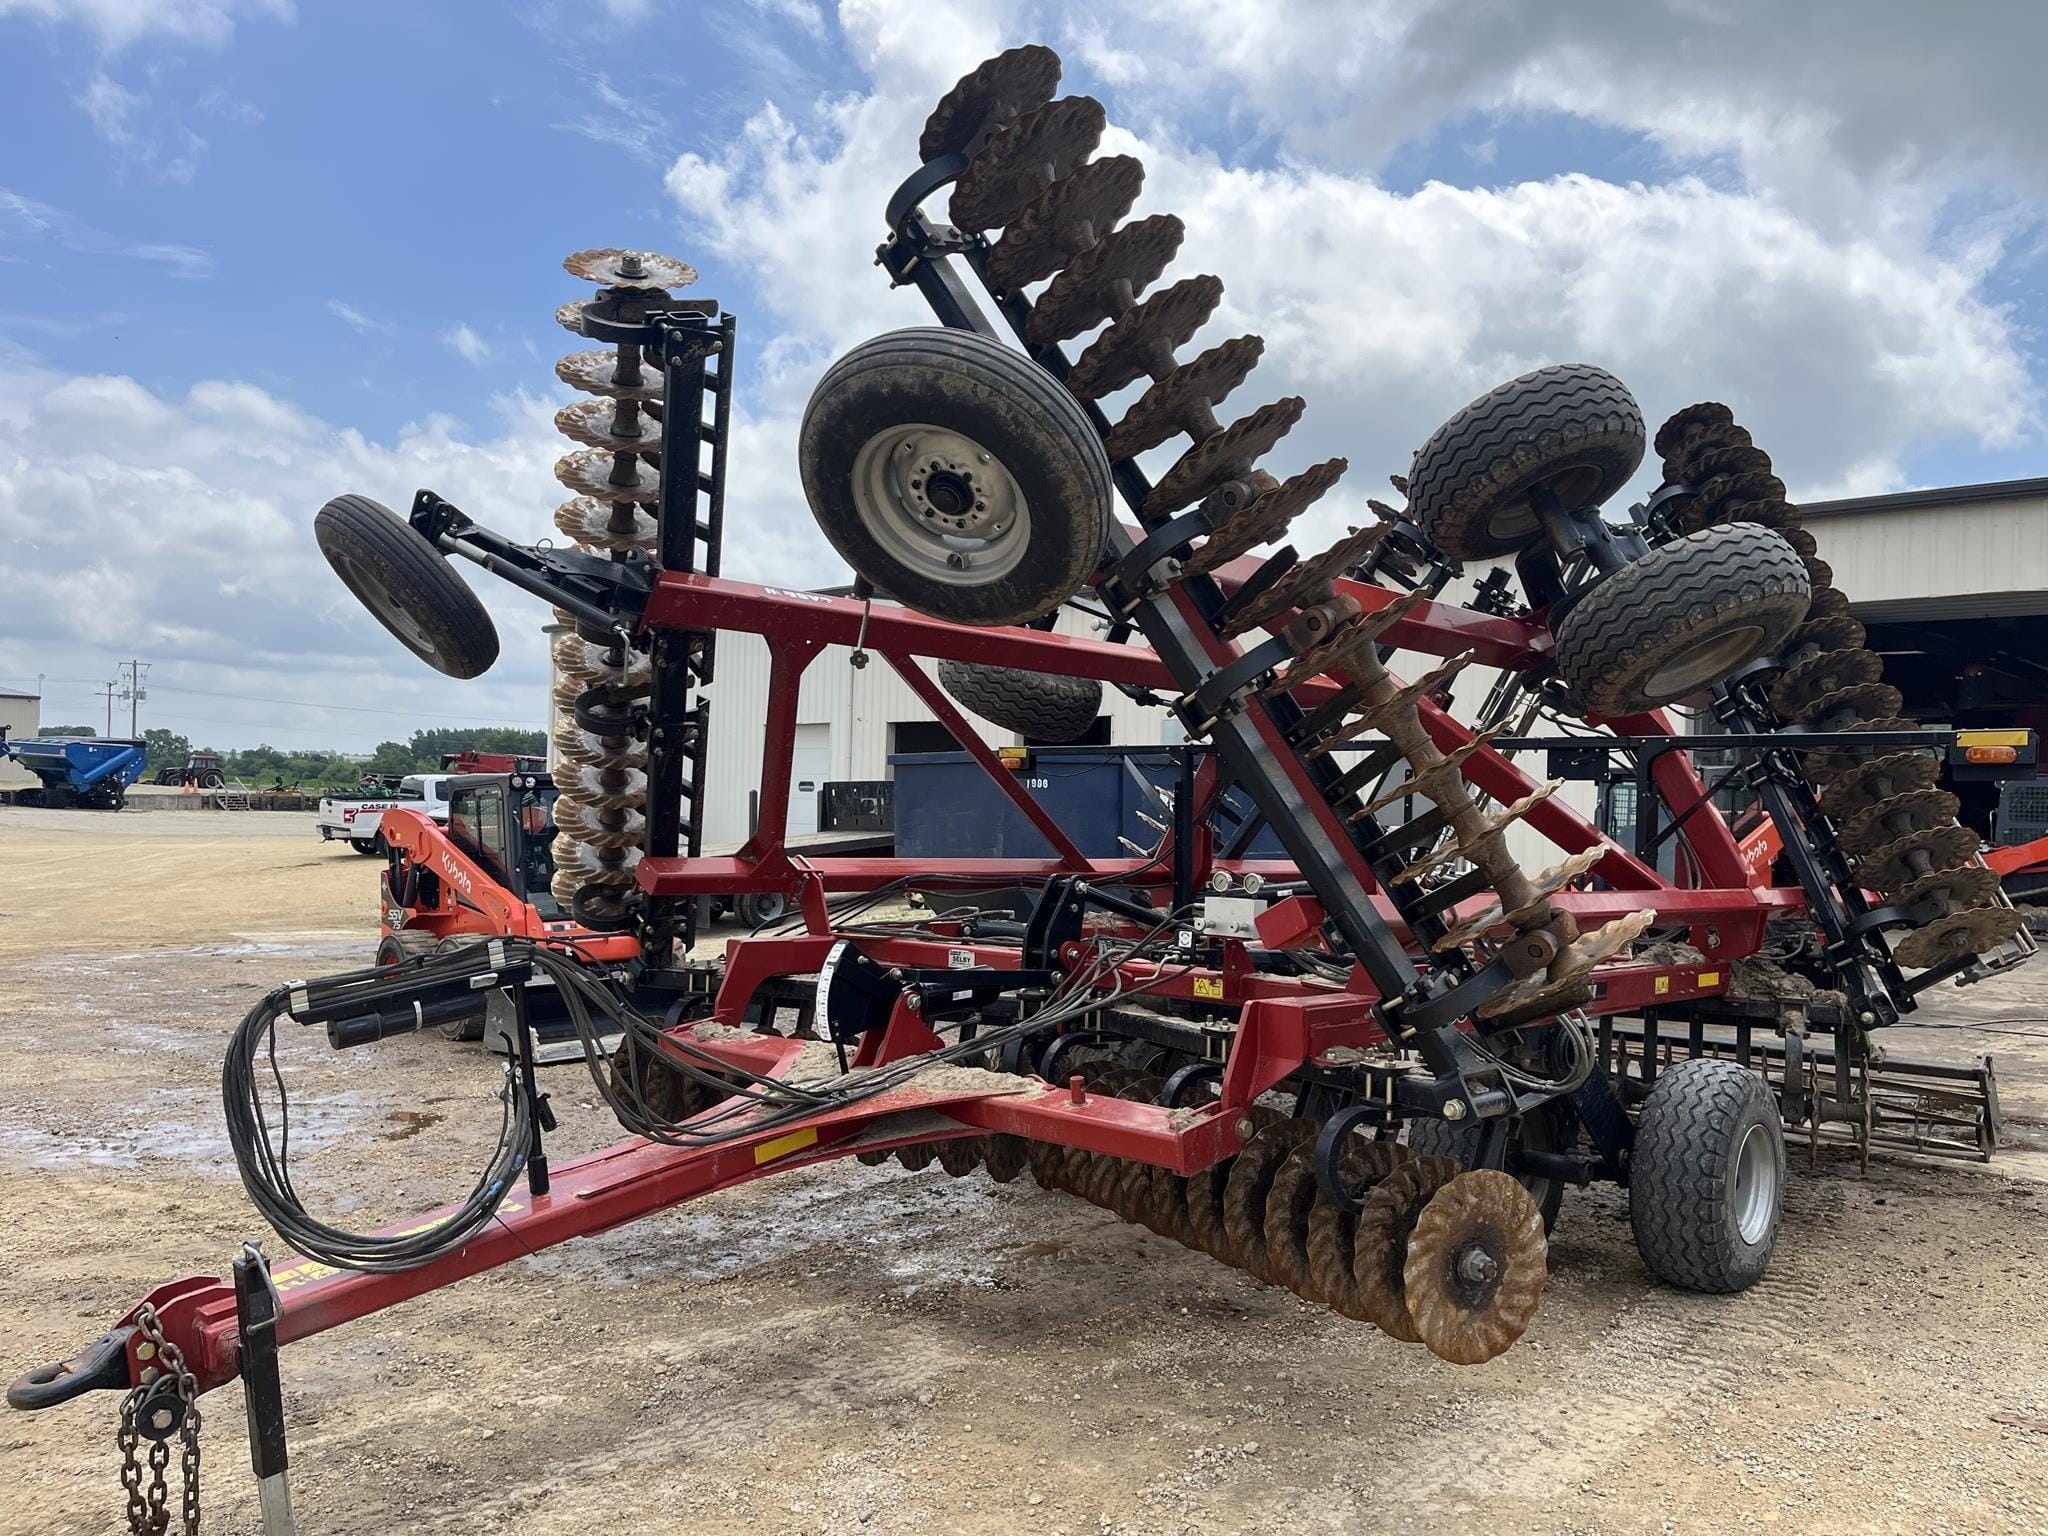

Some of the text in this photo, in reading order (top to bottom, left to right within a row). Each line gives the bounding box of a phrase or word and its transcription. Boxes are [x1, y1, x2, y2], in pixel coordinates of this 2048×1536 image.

[441, 850, 472, 894] Kubota
[387, 909, 404, 921] SSV
[392, 920, 401, 930] 75
